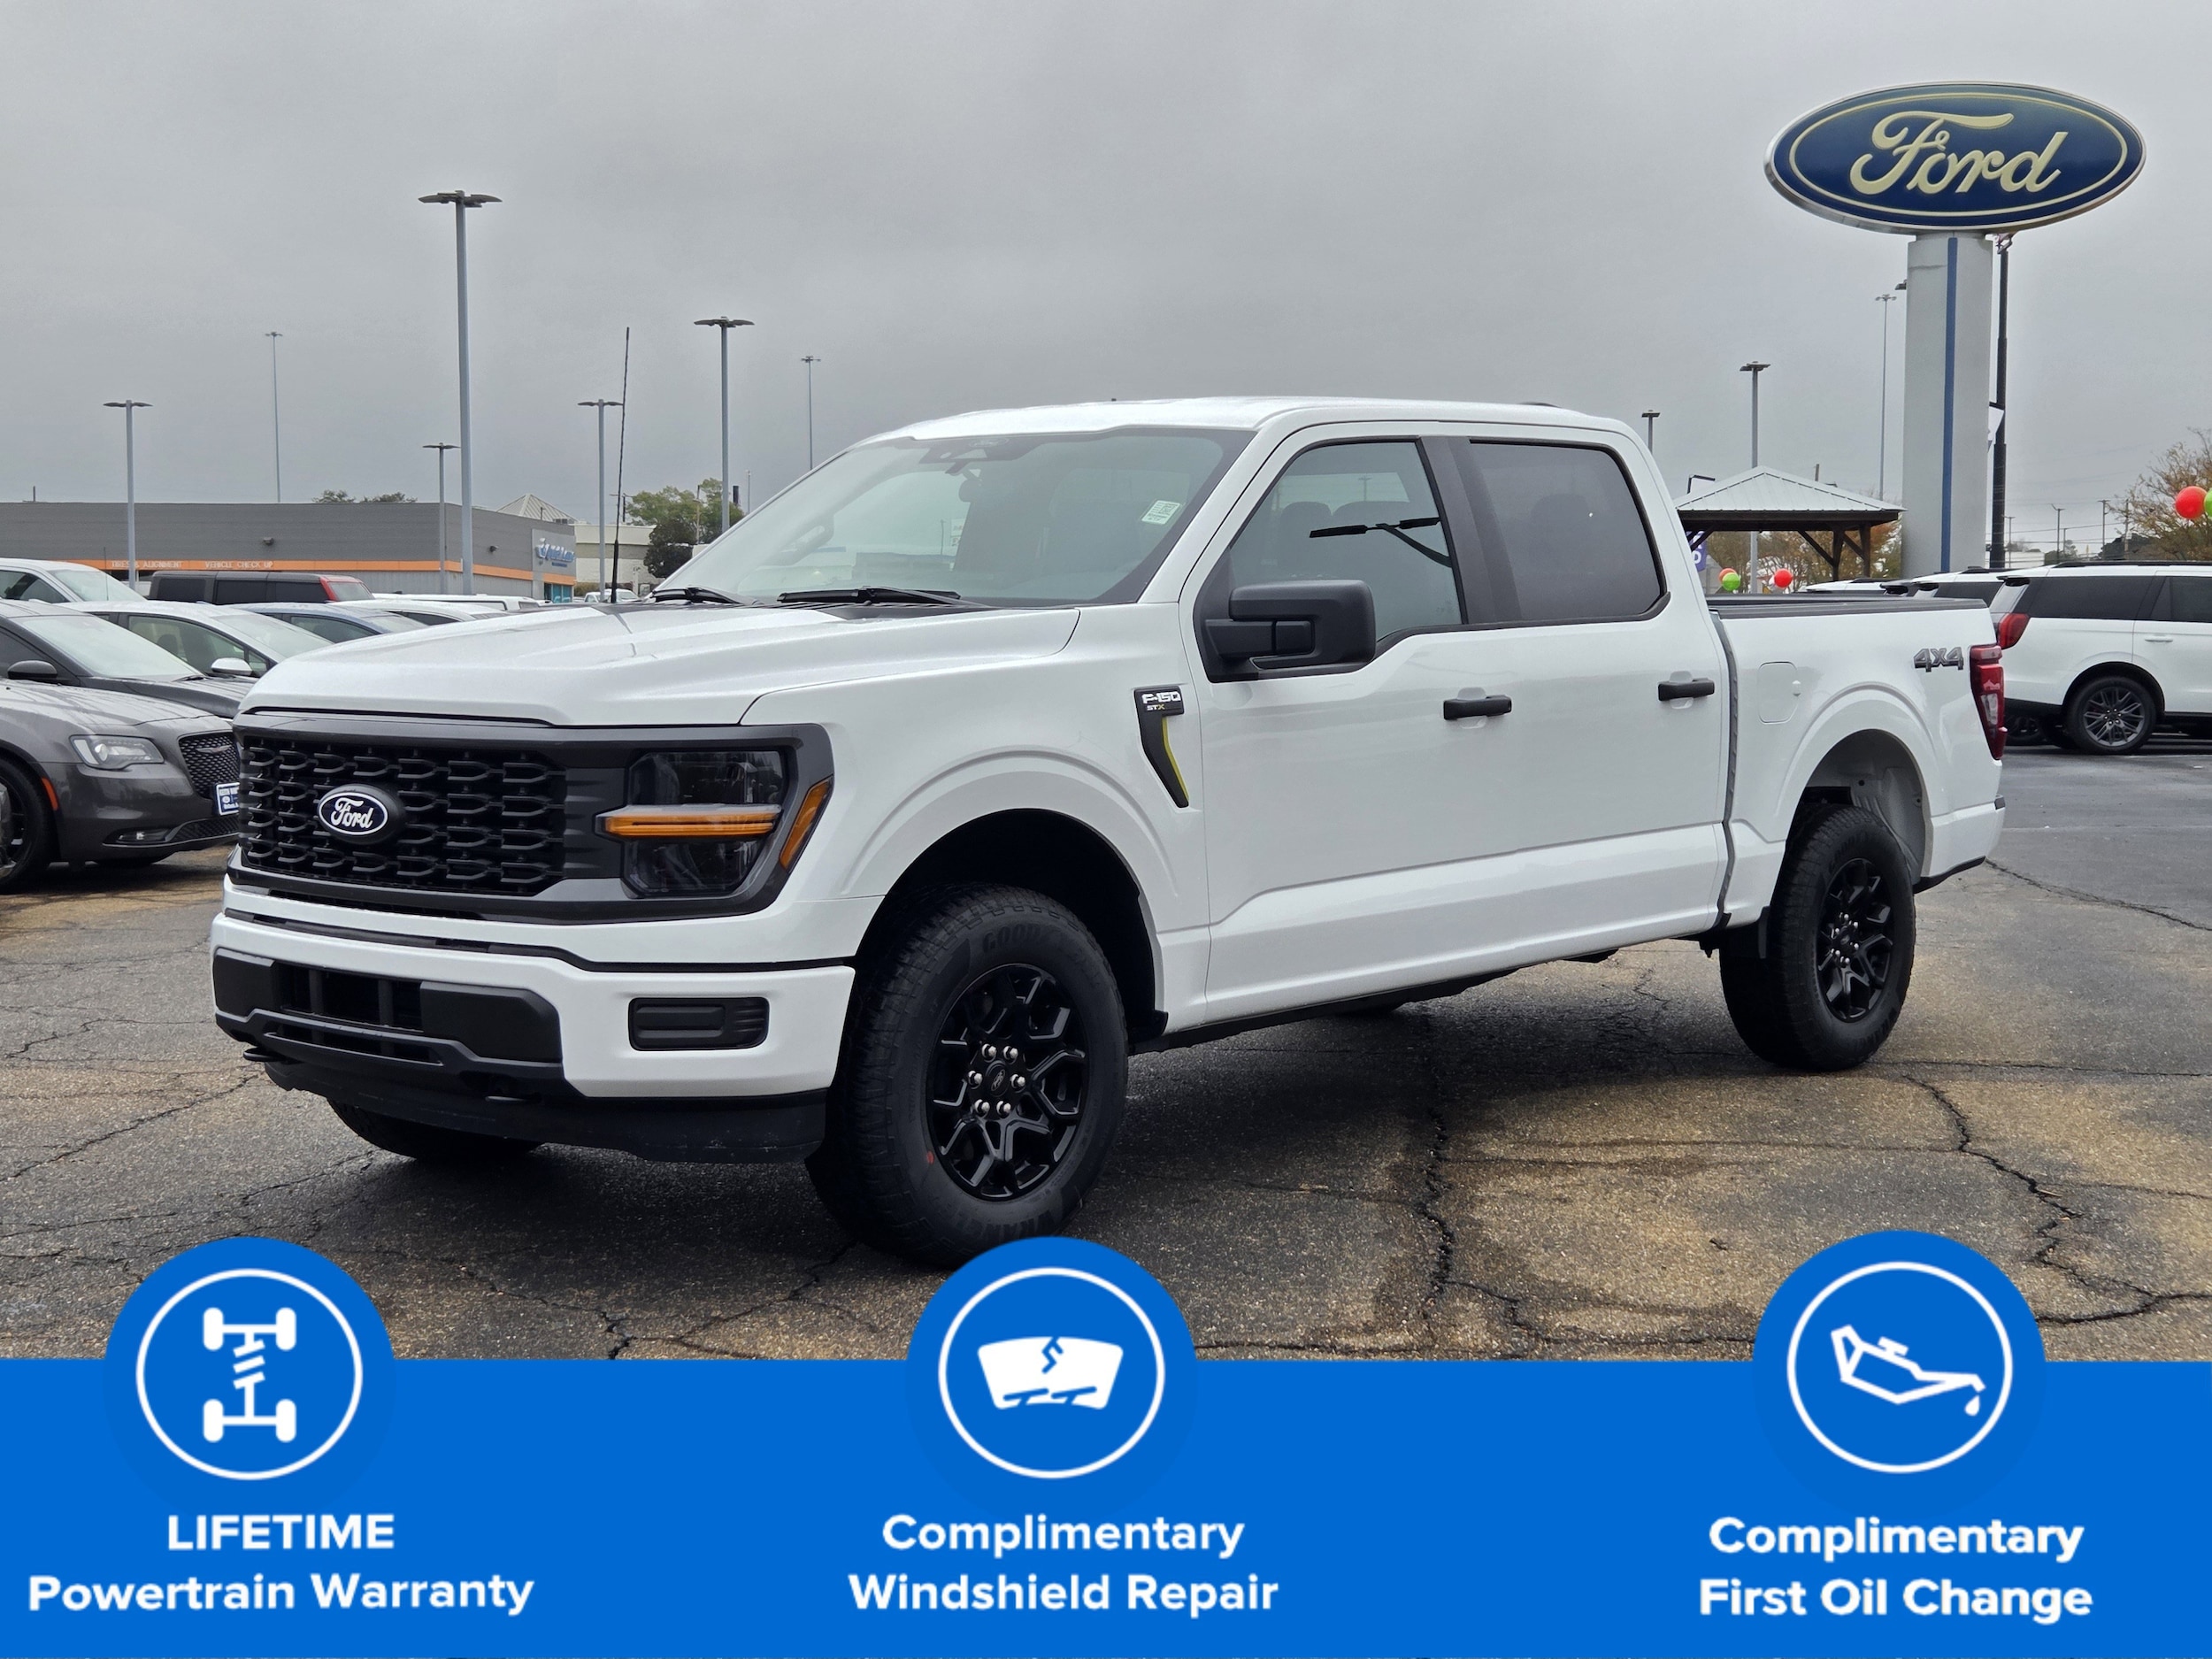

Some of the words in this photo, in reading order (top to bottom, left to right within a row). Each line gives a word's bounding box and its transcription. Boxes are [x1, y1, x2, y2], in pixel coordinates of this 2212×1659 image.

[1849, 110, 2069, 196] Ford
[204, 560, 234, 569] VEHICLE
[236, 560, 261, 569] CHECK
[263, 560, 273, 569] UP
[1141, 691, 1181, 703] F-150
[330, 796, 374, 829] Ford
